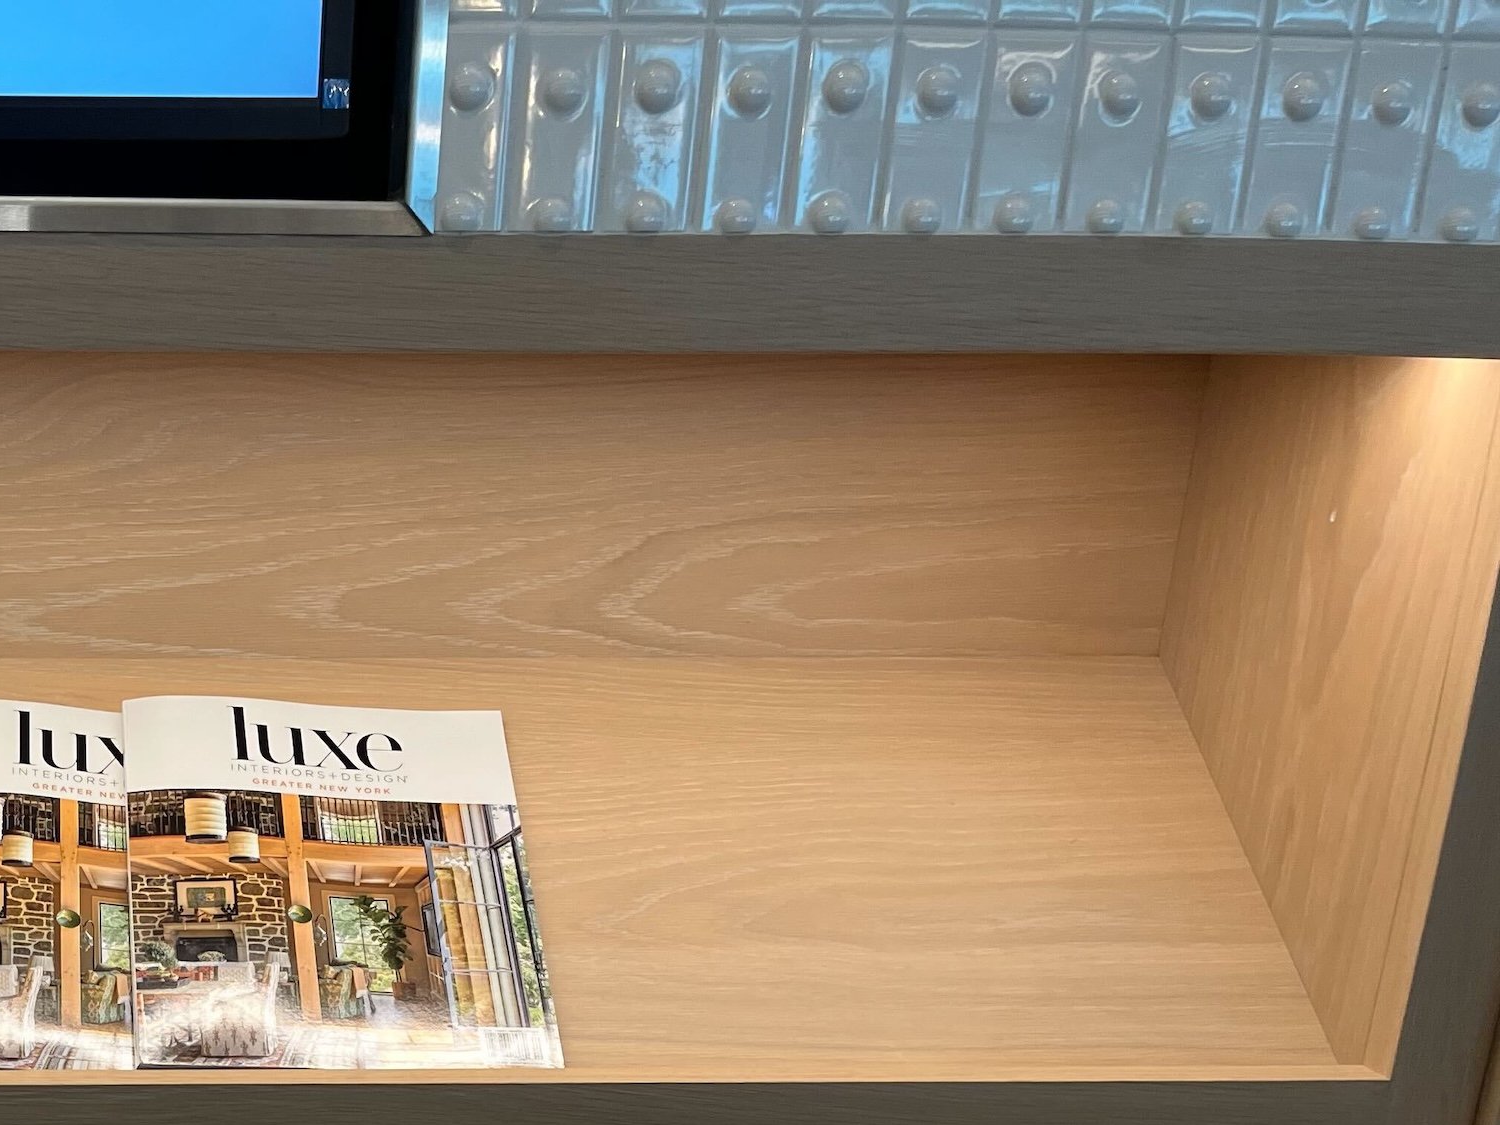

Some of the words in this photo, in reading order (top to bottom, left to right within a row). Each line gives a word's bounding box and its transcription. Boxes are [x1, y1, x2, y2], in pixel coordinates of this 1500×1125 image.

[227, 705, 403, 773] luxe
[32, 782, 93, 796] GREATER
[252, 777, 313, 790] GREATER
[319, 784, 350, 794] NEW
[355, 786, 392, 796] YORK
